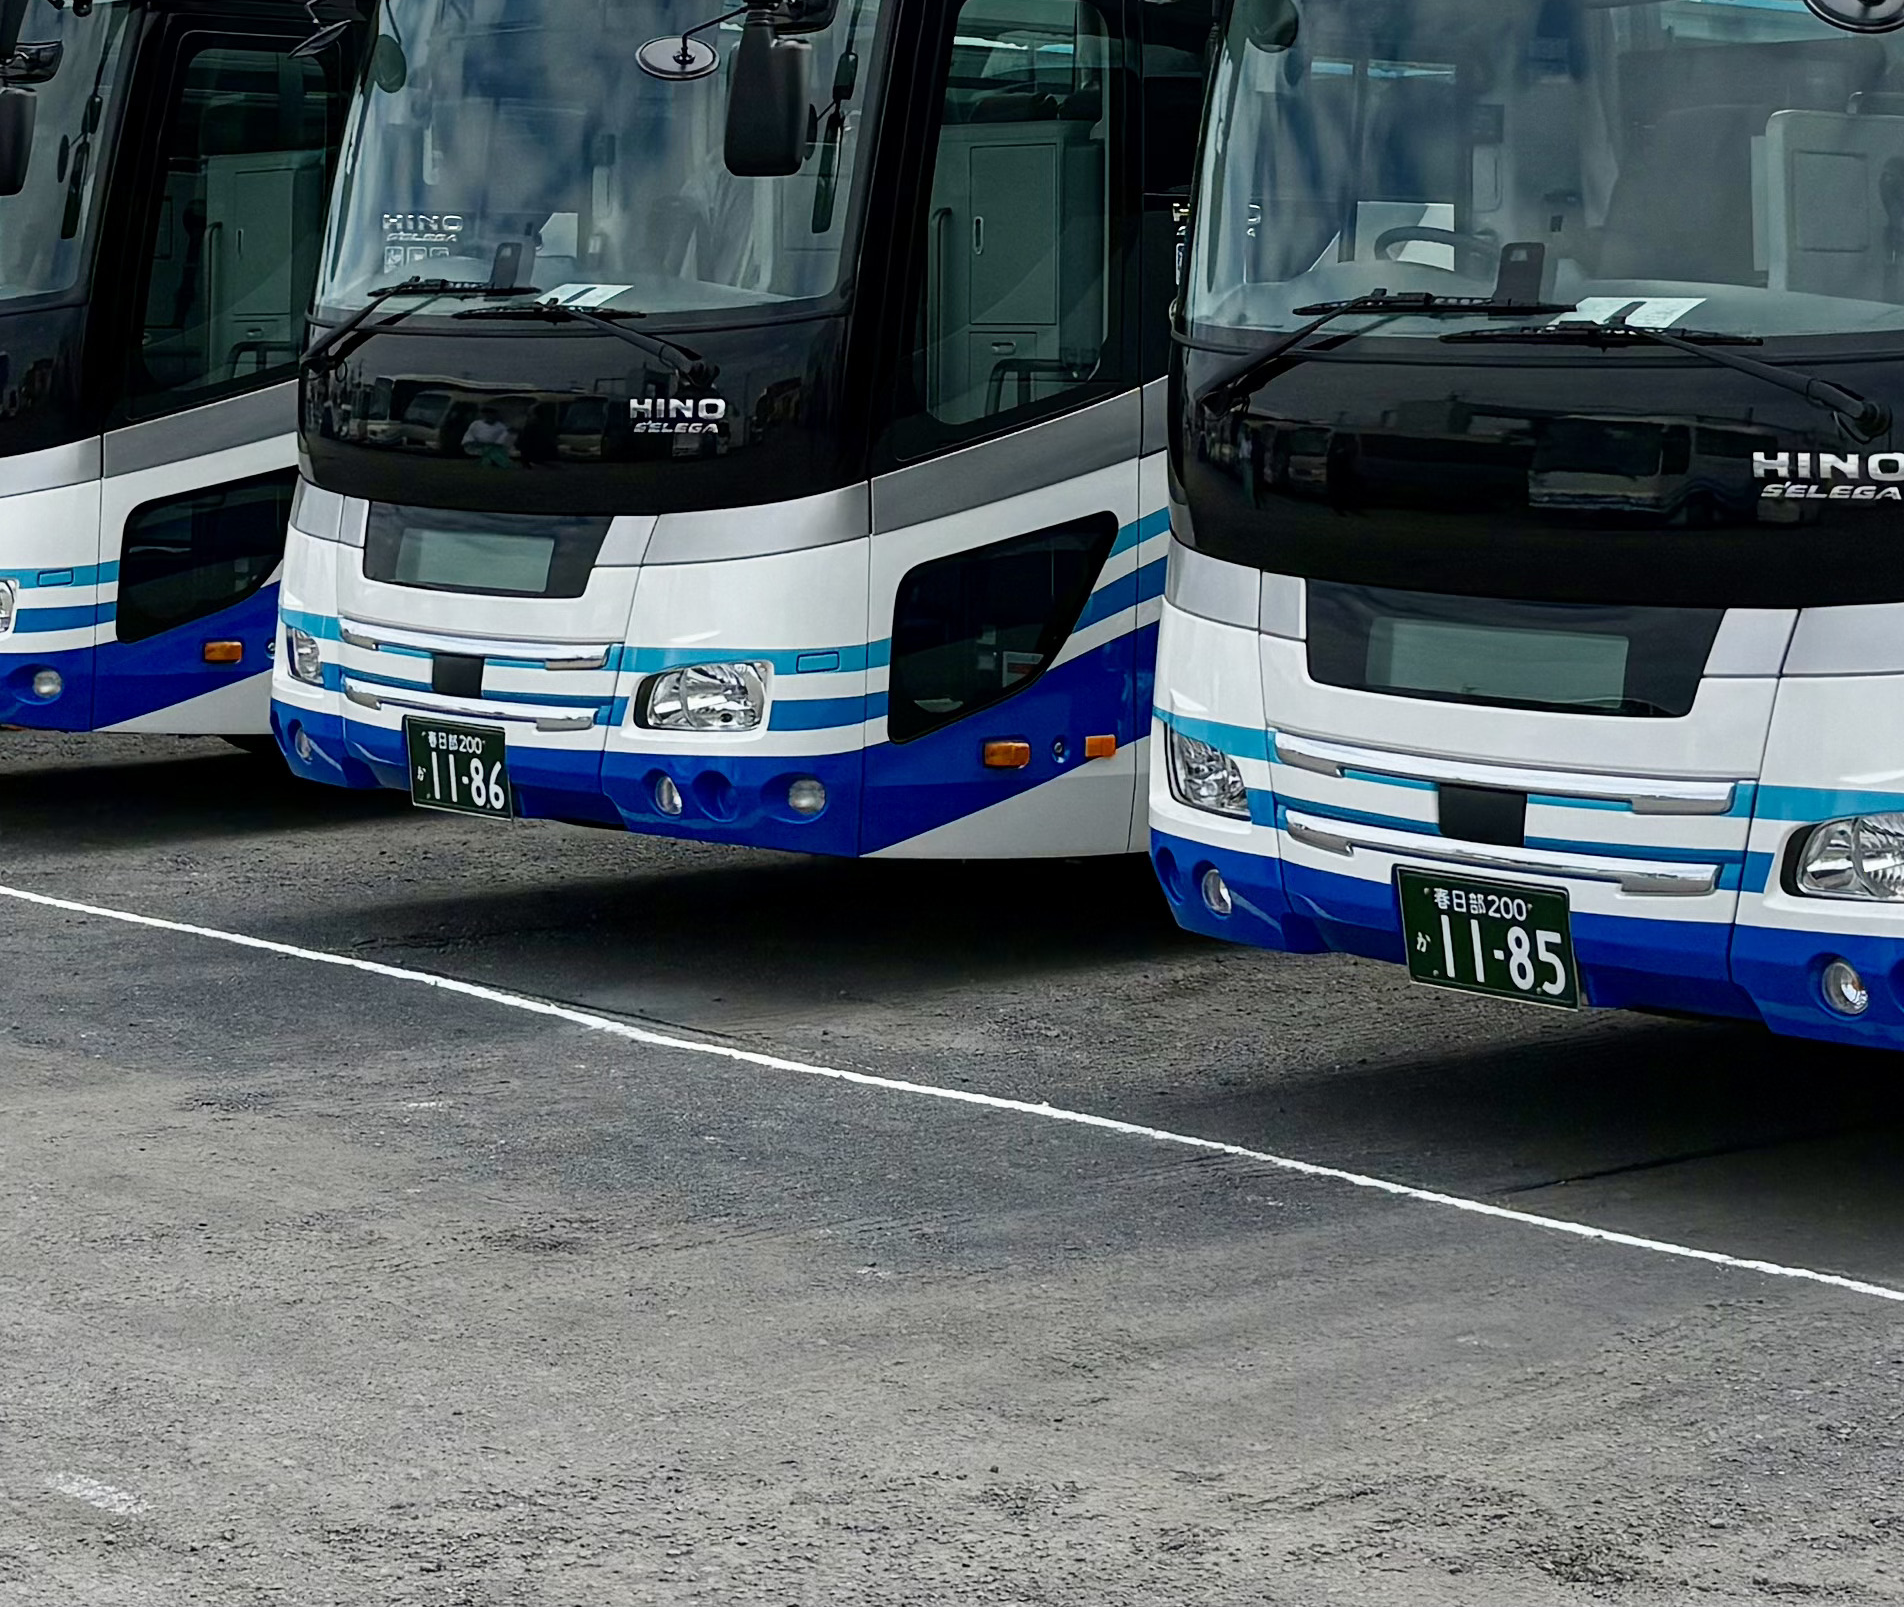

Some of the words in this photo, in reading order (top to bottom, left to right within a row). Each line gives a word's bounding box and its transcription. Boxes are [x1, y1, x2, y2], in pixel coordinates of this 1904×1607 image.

[629, 398, 726, 419] HINO
[431, 751, 505, 810] 11-86
[1416, 931, 1432, 953] か
[1440, 914, 1566, 996] 11-85
